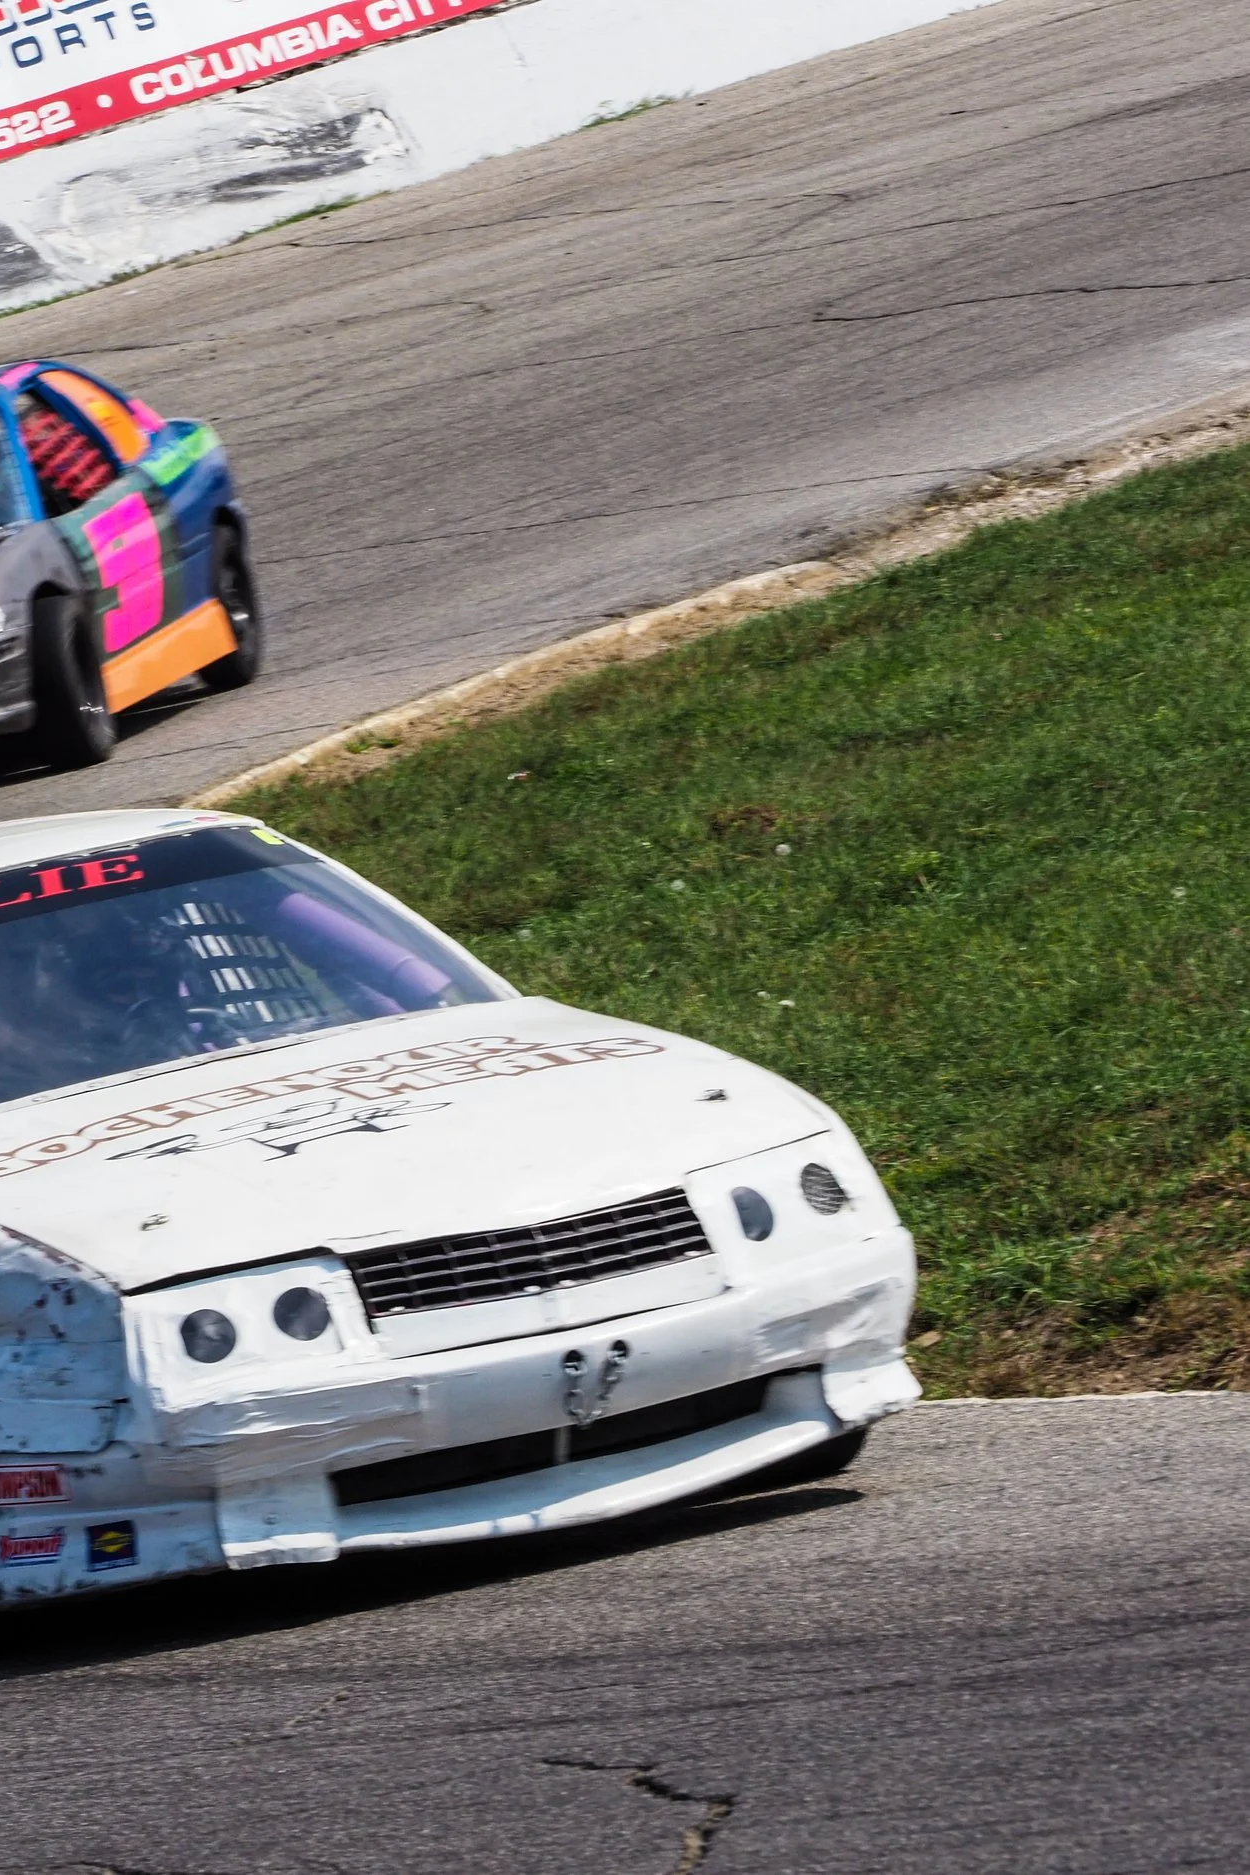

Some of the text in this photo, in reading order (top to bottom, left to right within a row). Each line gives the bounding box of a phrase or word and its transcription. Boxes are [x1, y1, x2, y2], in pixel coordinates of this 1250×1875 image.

[129, 14, 364, 105] COLUMBIA
[365, 0, 463, 31] CIT
[330, 1038, 666, 1101] MEATS
